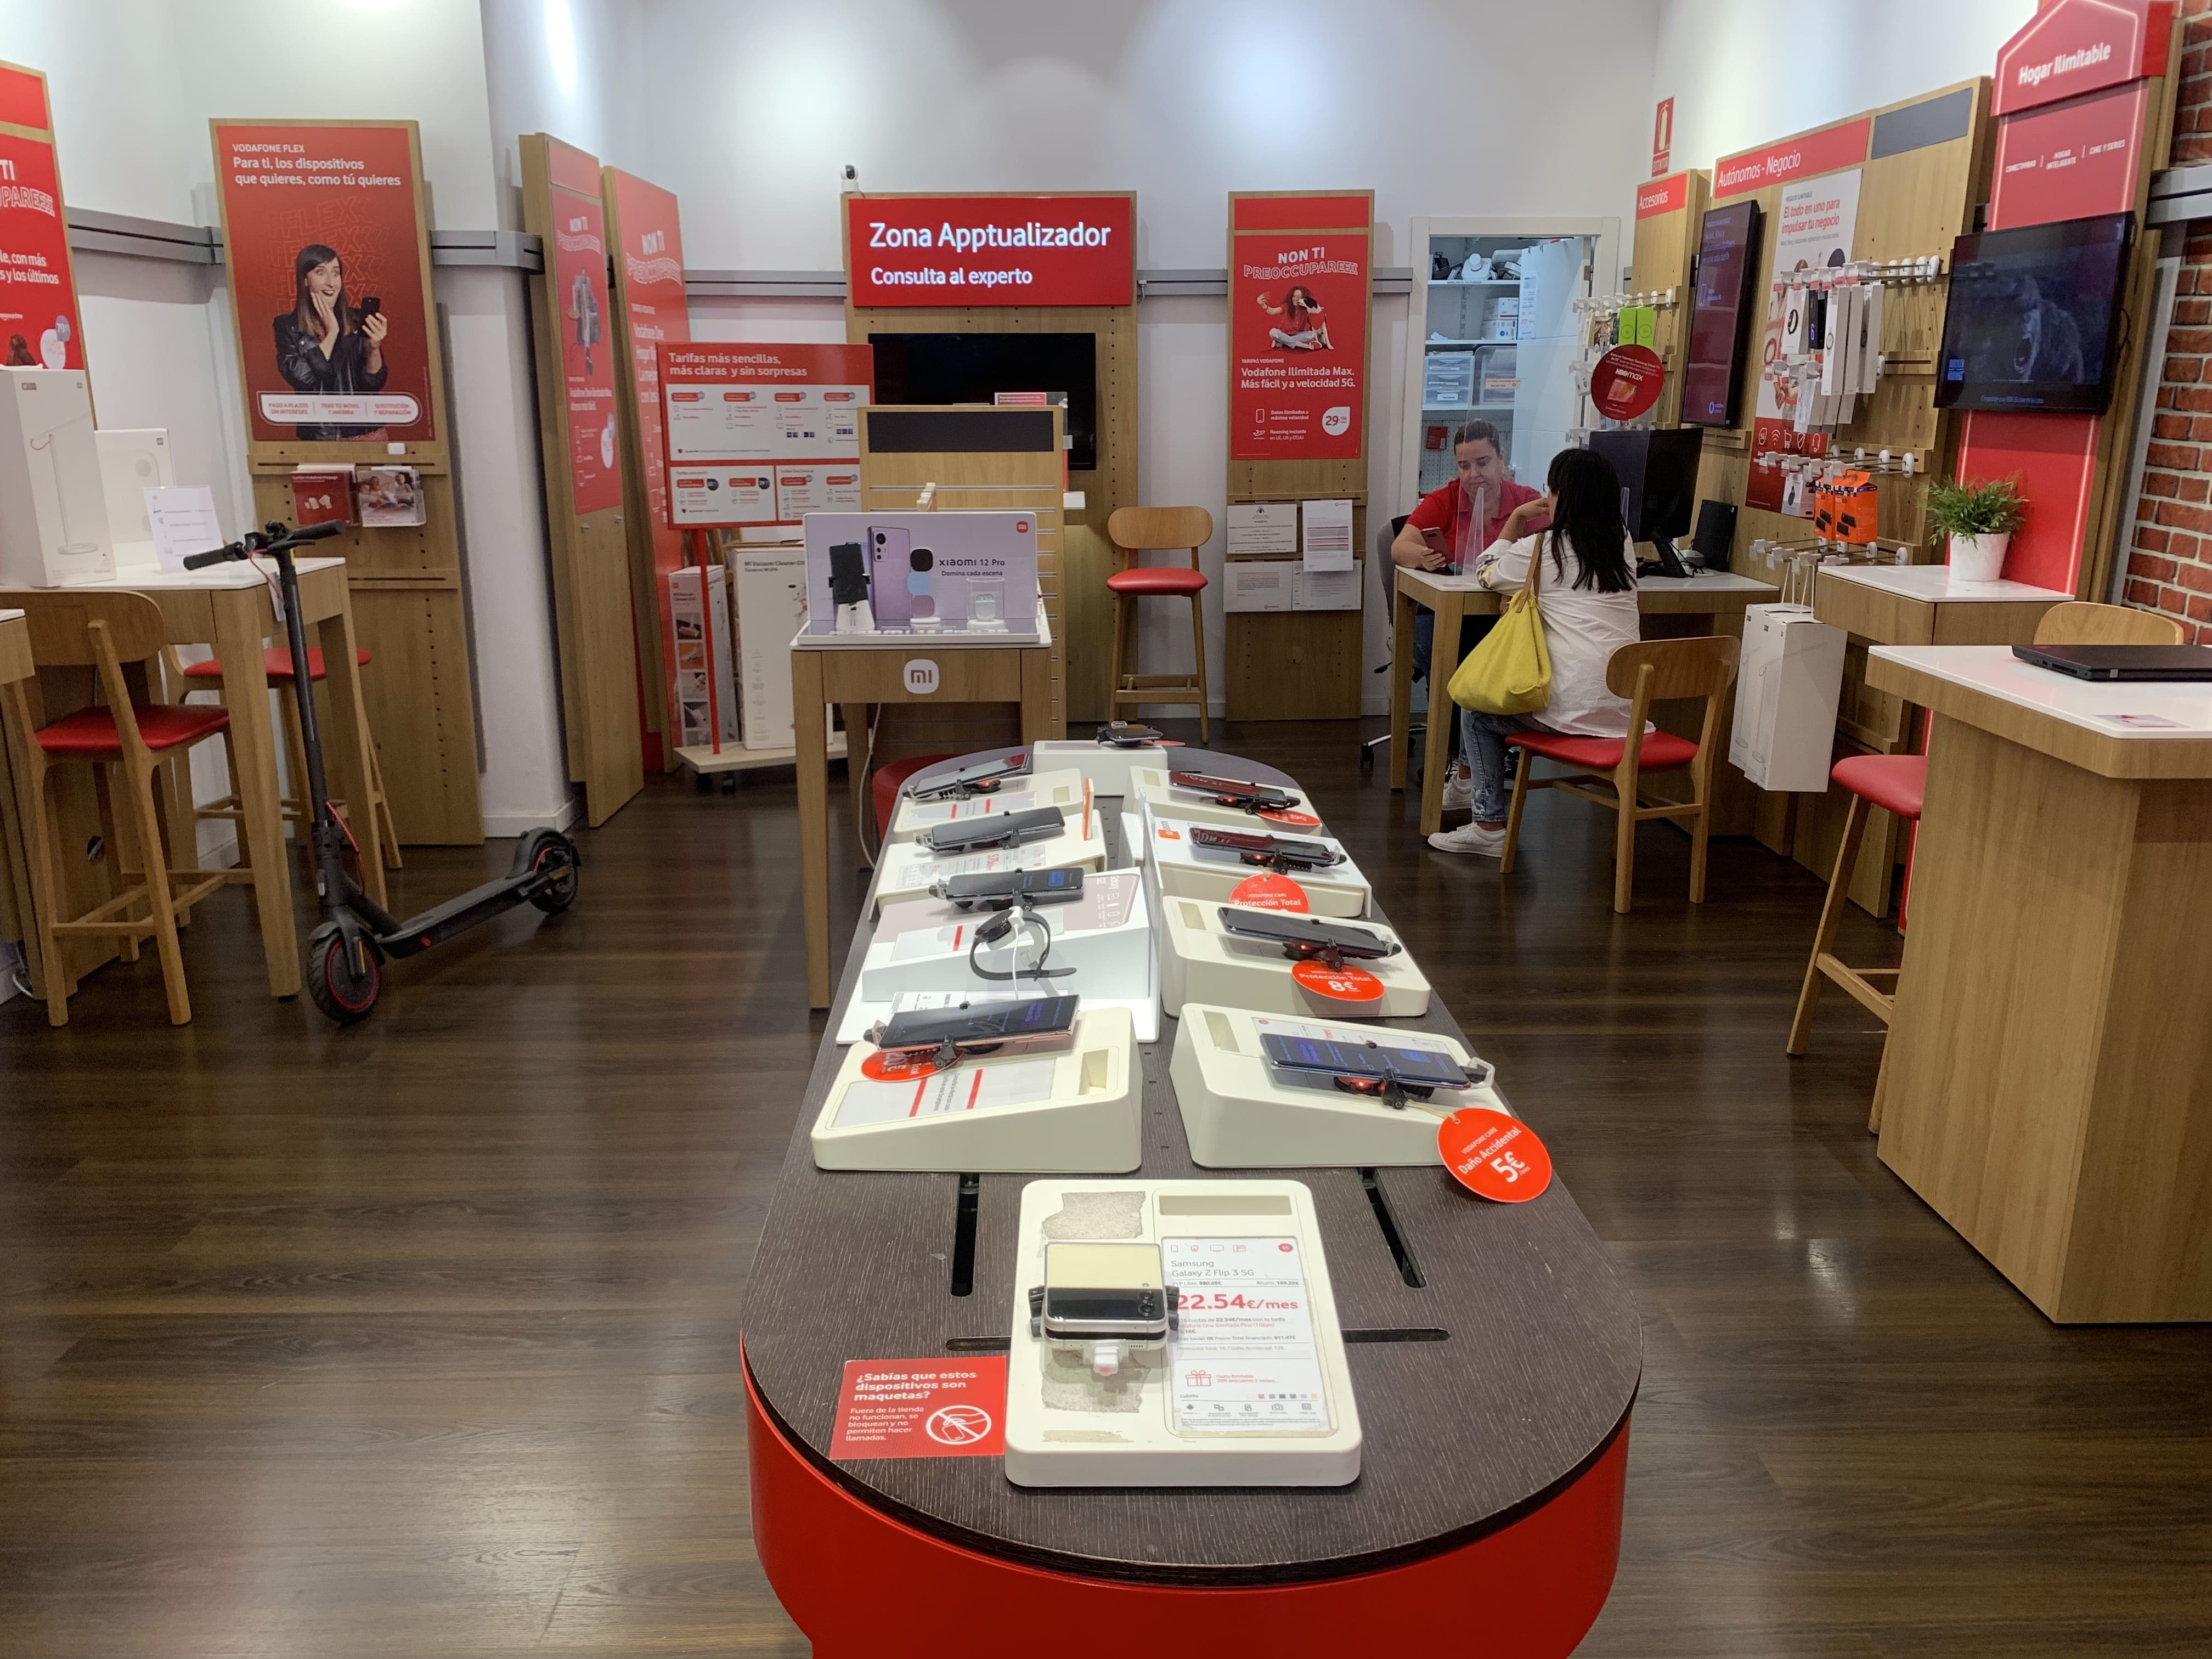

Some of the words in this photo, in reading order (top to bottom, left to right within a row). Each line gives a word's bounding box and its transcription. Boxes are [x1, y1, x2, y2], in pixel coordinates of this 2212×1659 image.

[2018, 62, 2052, 86] Hogar
[2054, 42, 2111, 74] Ilimitable
[233, 144, 281, 153] VODAFONE
[283, 144, 304, 153] FLEX
[233, 157, 258, 168] Para
[262, 158, 273, 170] ti,
[275, 158, 292, 169] los
[296, 158, 364, 171] dispositivos
[1652, 156, 1668, 172] EXTINTOR
[1718, 162, 1760, 189] Autónomos
[1767, 149, 1801, 178] Negocio
[235, 176, 257, 186] que
[260, 173, 306, 187] quieres,
[308, 175, 340, 185] como
[343, 174, 356, 185] tú
[358, 174, 401, 188] quieres
[1639, 188, 1668, 211] Accesorios
[1784, 207, 1790, 218] El
[1791, 204, 1804, 217] todo
[1805, 205, 1812, 215] en
[1813, 202, 1825, 213] uno
[1826, 199, 1840, 213] para
[1782, 219, 1807, 236] impulsar
[1808, 219, 1815, 230] tu
[1816, 213, 1840, 232] negocio
[870, 223, 932, 247] Zona
[938, 222, 1111, 253] Apptualizador
[12, 253, 27, 265] con
[28, 253, 47, 266] más
[1278, 249, 1308, 264] NON
[1312, 247, 1325, 259] TI
[7, 272, 12, 284] y
[13, 268, 27, 281] los
[27, 269, 59, 284] últimos
[871, 267, 945, 285] Consulta
[950, 268, 965, 284] al
[969, 268, 1032, 287] experto
[668, 352, 705, 364] Tarifas
[708, 353, 730, 364] más
[732, 353, 781, 365] sencillas,
[670, 365, 693, 375] más
[695, 365, 726, 376] claras
[731, 368, 738, 378] y
[740, 366, 755, 376] sin
[758, 367, 807, 379] sorpresas
[1242, 367, 1286, 377] Vodafone
[1288, 366, 1330, 376] Ilimitada
[1332, 366, 1354, 376] Max.
[1242, 379, 1260, 388] Más
[1261, 378, 1280, 388] fácil
[1282, 381, 1288, 390] y
[1296, 378, 1340, 388] velocidad
[1341, 378, 1356, 387] 5G.
[1325, 415, 1339, 426] 29
[992, 558, 1005, 567] Pro
[1234, 898, 1279, 907] Protección
[1299, 972, 1348, 981] Protección
[1328, 980, 1359, 992] 8€
[1461, 1136, 1487, 1154] VODAFONE
[1485, 1126, 1498, 1139] CARE
[1457, 1154, 1482, 1175] Daño
[1479, 1126, 1522, 1160] Accidental
[1490, 1151, 1525, 1183] 5€
[1171, 1260, 1214, 1269] Samsung
[1172, 1269, 1202, 1278] Galaxy
[1214, 1269, 1230, 1277] Flip
[1177, 1294, 1299, 1310] 22.54€/mes
[857, 1373, 908, 1383] ¿Sabías
[911, 1373, 936, 1382] que
[940, 1371, 977, 1379] estos
[855, 1381, 939, 1392] dispositivos
[854, 1391, 930, 1402] maquetas?
[847, 1427, 886, 1436] permiten
